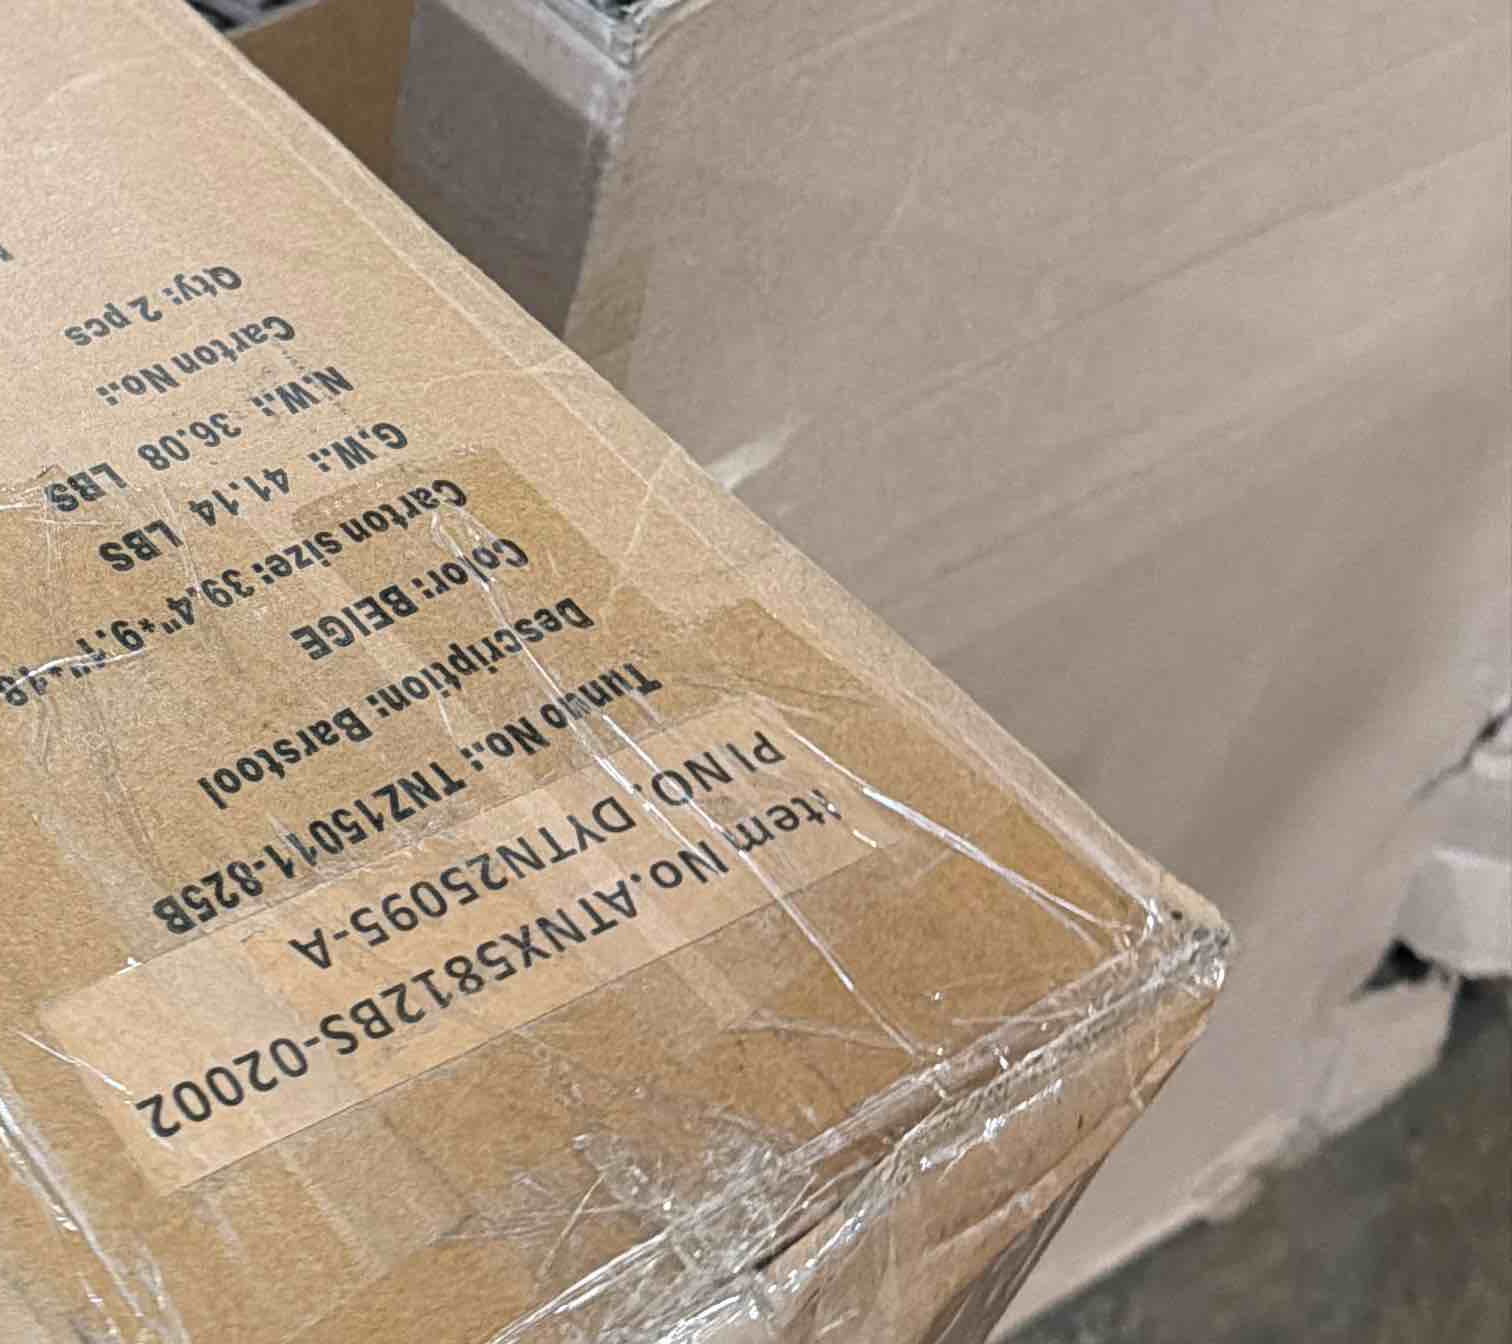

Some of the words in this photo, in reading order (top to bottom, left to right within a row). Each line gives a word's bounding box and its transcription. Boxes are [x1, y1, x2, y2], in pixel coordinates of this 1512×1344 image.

[127, 295, 163, 323] 2
[162, 266, 242, 305] Qty:
[64, 302, 132, 346] pcs
[171, 316, 296, 374] Carton
[95, 364, 176, 406] No.:
[249, 366, 354, 417] N.W.:
[137, 413, 242, 471] 36.08
[307, 422, 408, 473] G.W.:
[49, 462, 127, 513] LBS
[187, 468, 290, 527] 41.14
[338, 479, 468, 543] Carton
[98, 519, 184, 572] LBS
[251, 531, 343, 585] size:
[411, 538, 529, 599] Color:
[289, 584, 418, 661] BEIGE
[365, 597, 595, 718] Description:
[196, 707, 372, 810] Barstool
[459, 716, 546, 772] No.:
[153, 761, 467, 935] TNZ15011-825B
[287, 796, 636, 970] DYTN25095-A
